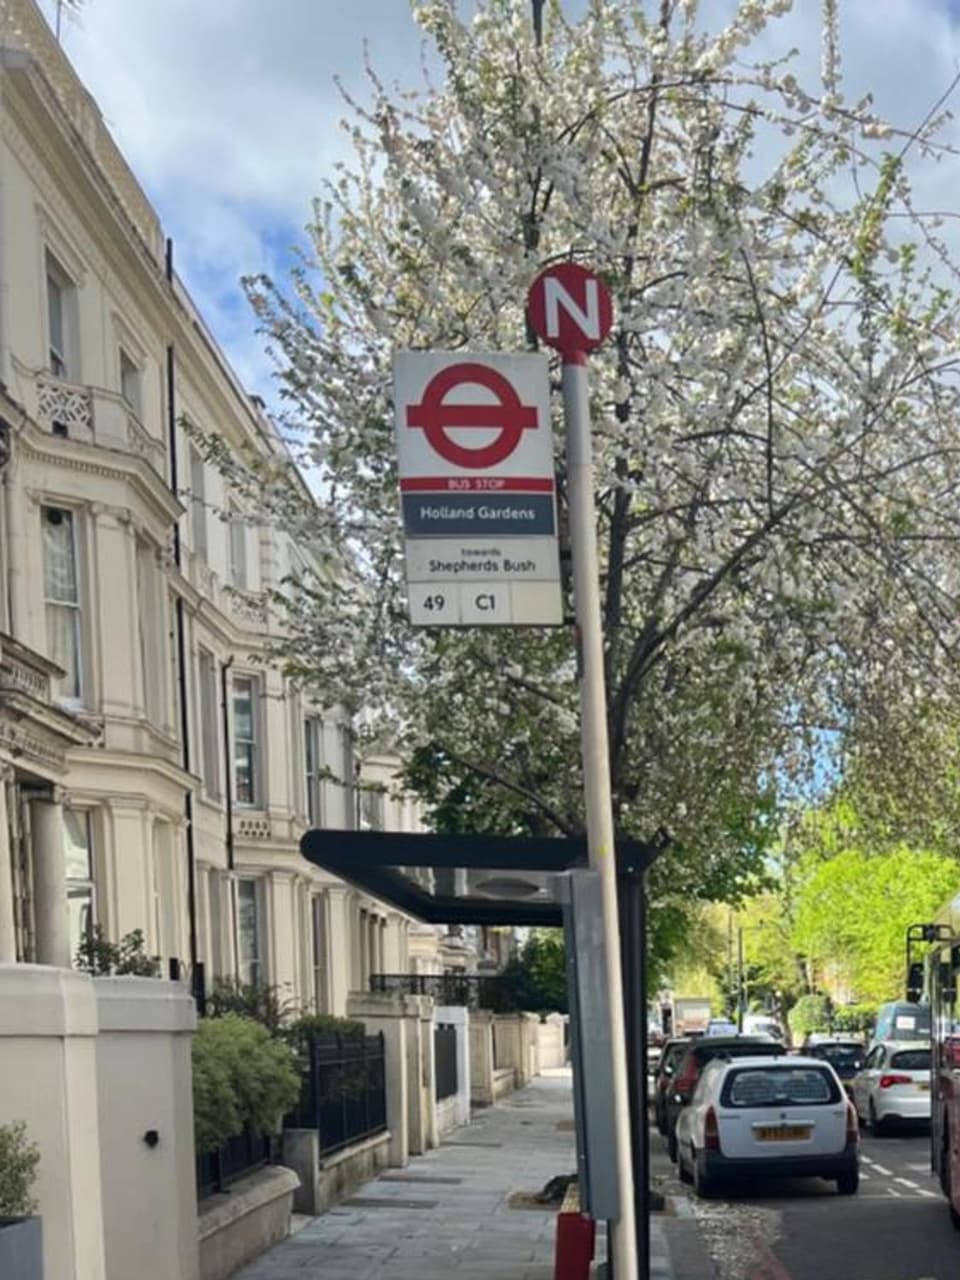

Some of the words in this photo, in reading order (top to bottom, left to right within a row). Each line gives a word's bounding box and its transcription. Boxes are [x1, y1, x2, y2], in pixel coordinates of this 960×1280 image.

[543, 276, 601, 340] N
[447, 478, 471, 489] BUS
[475, 478, 505, 489] STOP
[420, 506, 475, 520] Holland
[477, 506, 535, 520] Gardens
[428, 559, 499, 574] Shepherds
[502, 559, 536, 572] Bush
[423, 594, 446, 611] 49
[475, 594, 496, 611] C1
